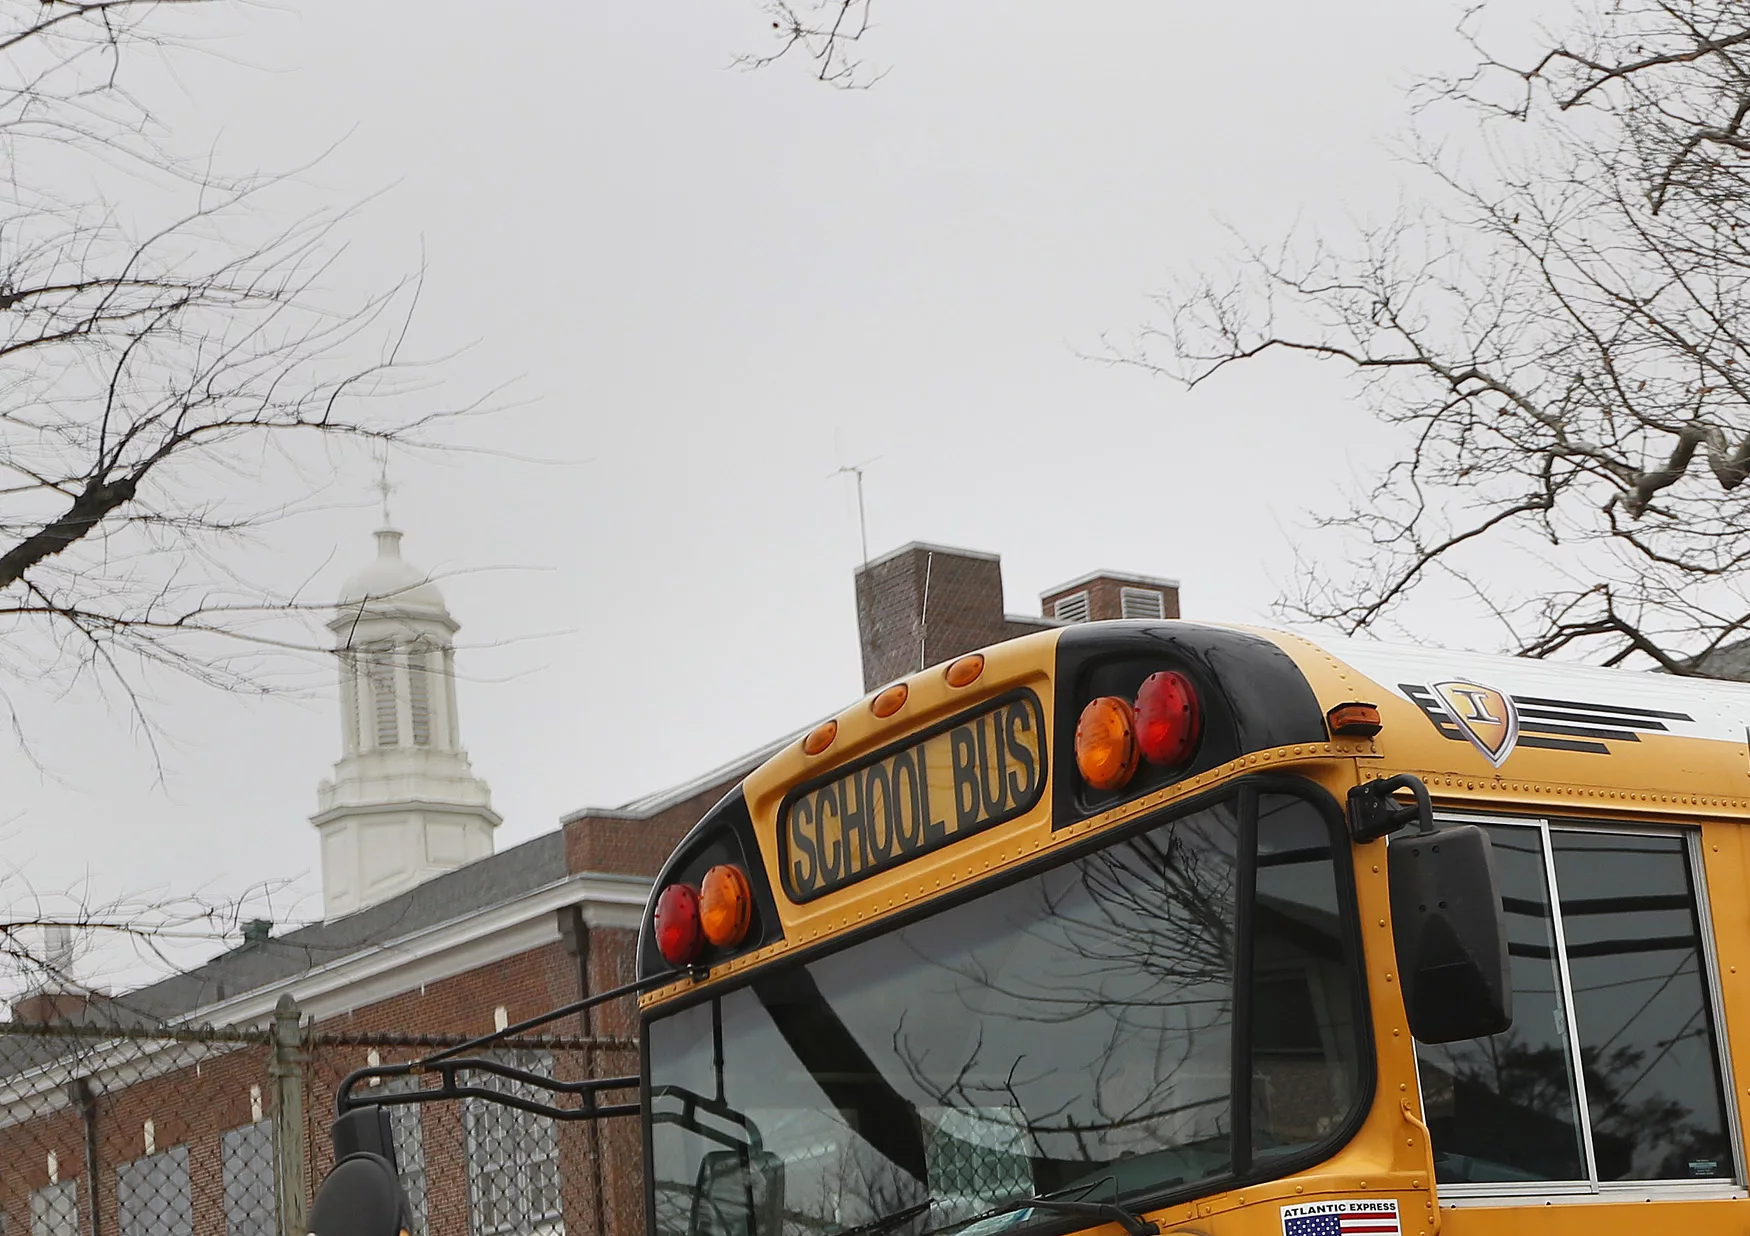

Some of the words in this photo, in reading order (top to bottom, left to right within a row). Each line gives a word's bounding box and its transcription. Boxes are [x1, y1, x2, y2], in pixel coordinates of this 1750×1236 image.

[791, 744, 946, 895] SCHOOL
[950, 699, 1035, 831] BUS
[1283, 1203, 1347, 1218] ATLANTIC
[1349, 1202, 1396, 1212] EXPRESS
